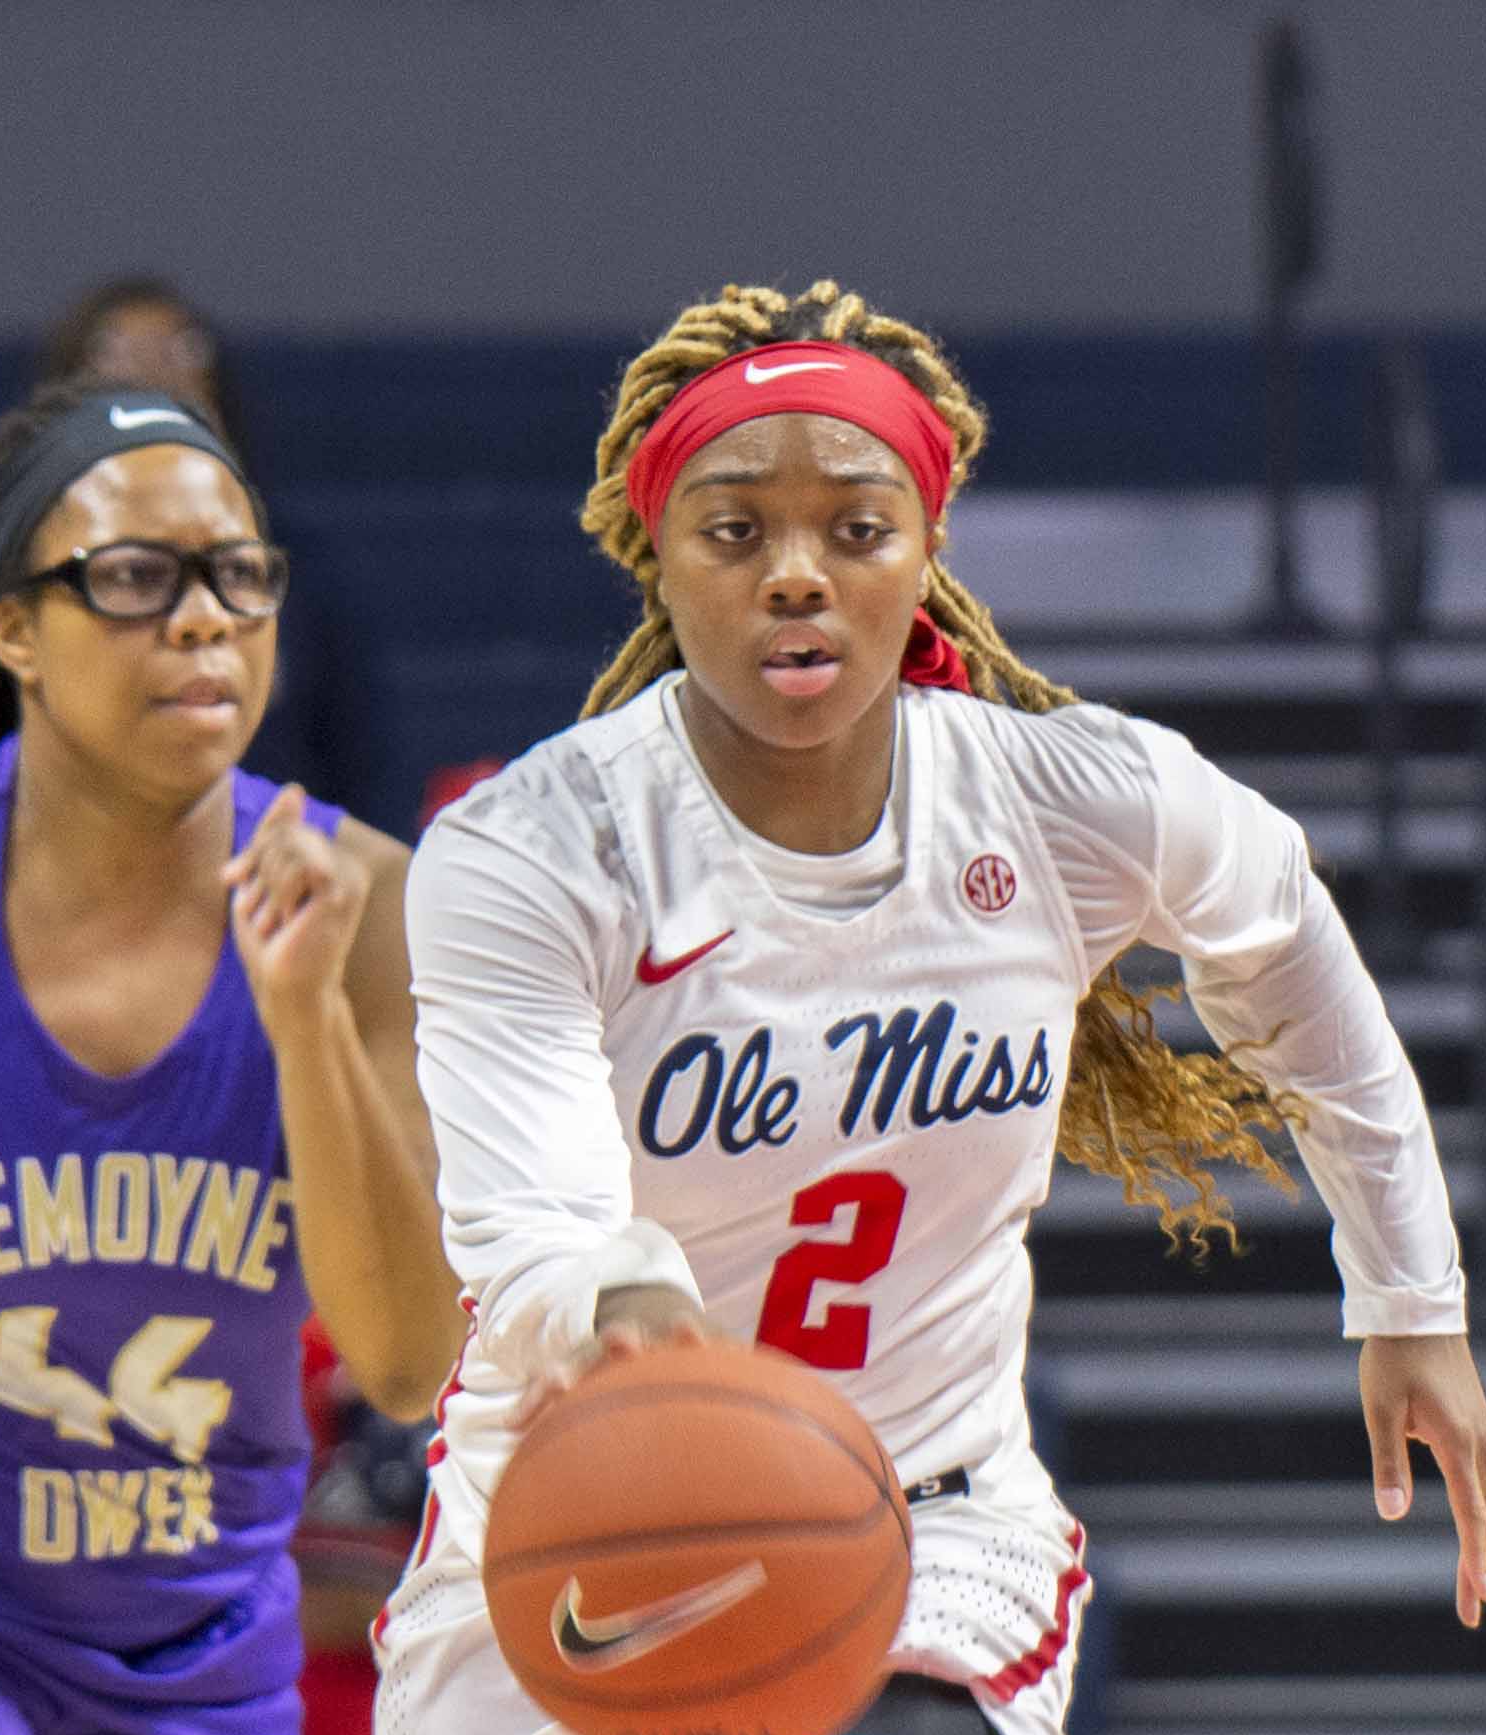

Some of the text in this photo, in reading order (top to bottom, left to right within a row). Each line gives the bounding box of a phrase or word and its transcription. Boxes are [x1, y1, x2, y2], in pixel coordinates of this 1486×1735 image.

[638, 1001, 1052, 1157] Ole Miss
[756, 1171, 908, 1370] 2
